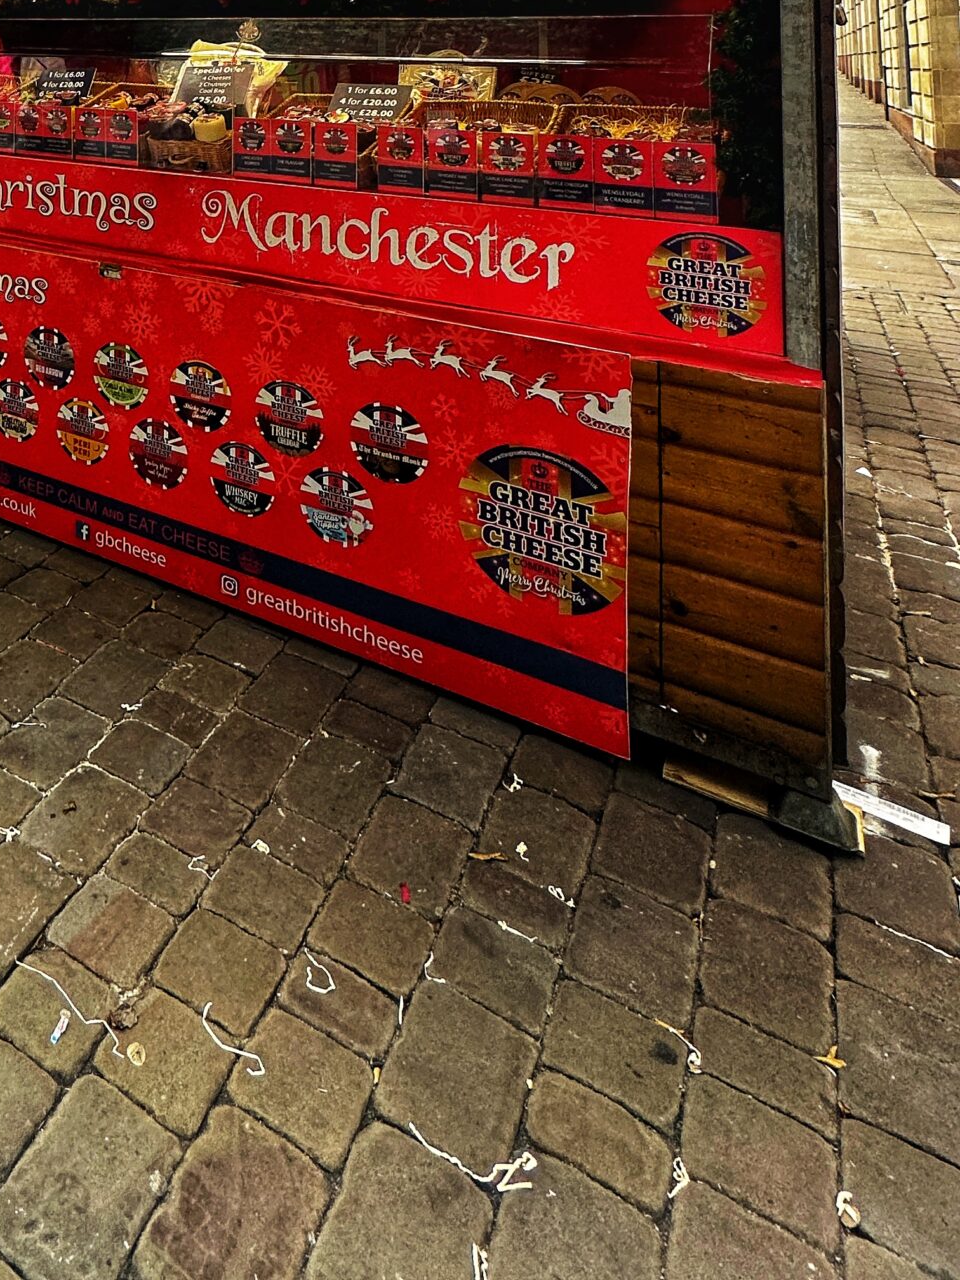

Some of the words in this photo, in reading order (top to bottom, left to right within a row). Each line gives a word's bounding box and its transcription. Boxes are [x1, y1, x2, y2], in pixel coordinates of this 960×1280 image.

[193, 66, 223, 75] Special
[347, 86, 353, 94] 1
[354, 86, 368, 94] for
[368, 87, 398, 95] £6.00
[339, 97, 346, 105] 4
[348, 97, 361, 106] for
[362, 98, 398, 107] £20.00
[359, 108, 394, 117] £28.00
[201, 190, 575, 292] Manchester
[666, 256, 743, 279] GREAT
[658, 269, 752, 297] BRITISH
[661, 286, 750, 312] CHEESE
[672, 312, 700, 327] Merry
[270, 401, 308, 417] BRITISH
[273, 393, 304, 408] GREAT
[271, 408, 306, 424] CHEESE
[270, 423, 308, 445] TRUFFLE
[368, 424, 408, 441] BRITISH
[372, 418, 405, 433] GREAT
[369, 432, 407, 449] CHEESE
[225, 461, 260, 477] BRITISH
[228, 455, 256, 470] GREAT
[226, 469, 259, 485] CHEESE
[527, 478, 553, 493] THE
[318, 489, 355, 506] BRITISH
[321, 483, 351, 498] GREAT
[319, 497, 354, 513] CHEESE
[487, 480, 595, 528] GREAT
[19, 473, 54, 498] KEEP
[57, 488, 98, 516] CALM
[102, 506, 125, 523] AND
[128, 512, 158, 536] EAT
[160, 522, 232, 563] CHEESE
[476, 498, 608, 557] BRITISH
[95, 529, 168, 568] gbcheese
[481, 523, 603, 580] CHEESE
[512, 557, 570, 581] COMPANY
[497, 566, 533, 592] Merry
[532, 575, 587, 606] Christmas
[245, 586, 424, 664] greatbritishcheese
